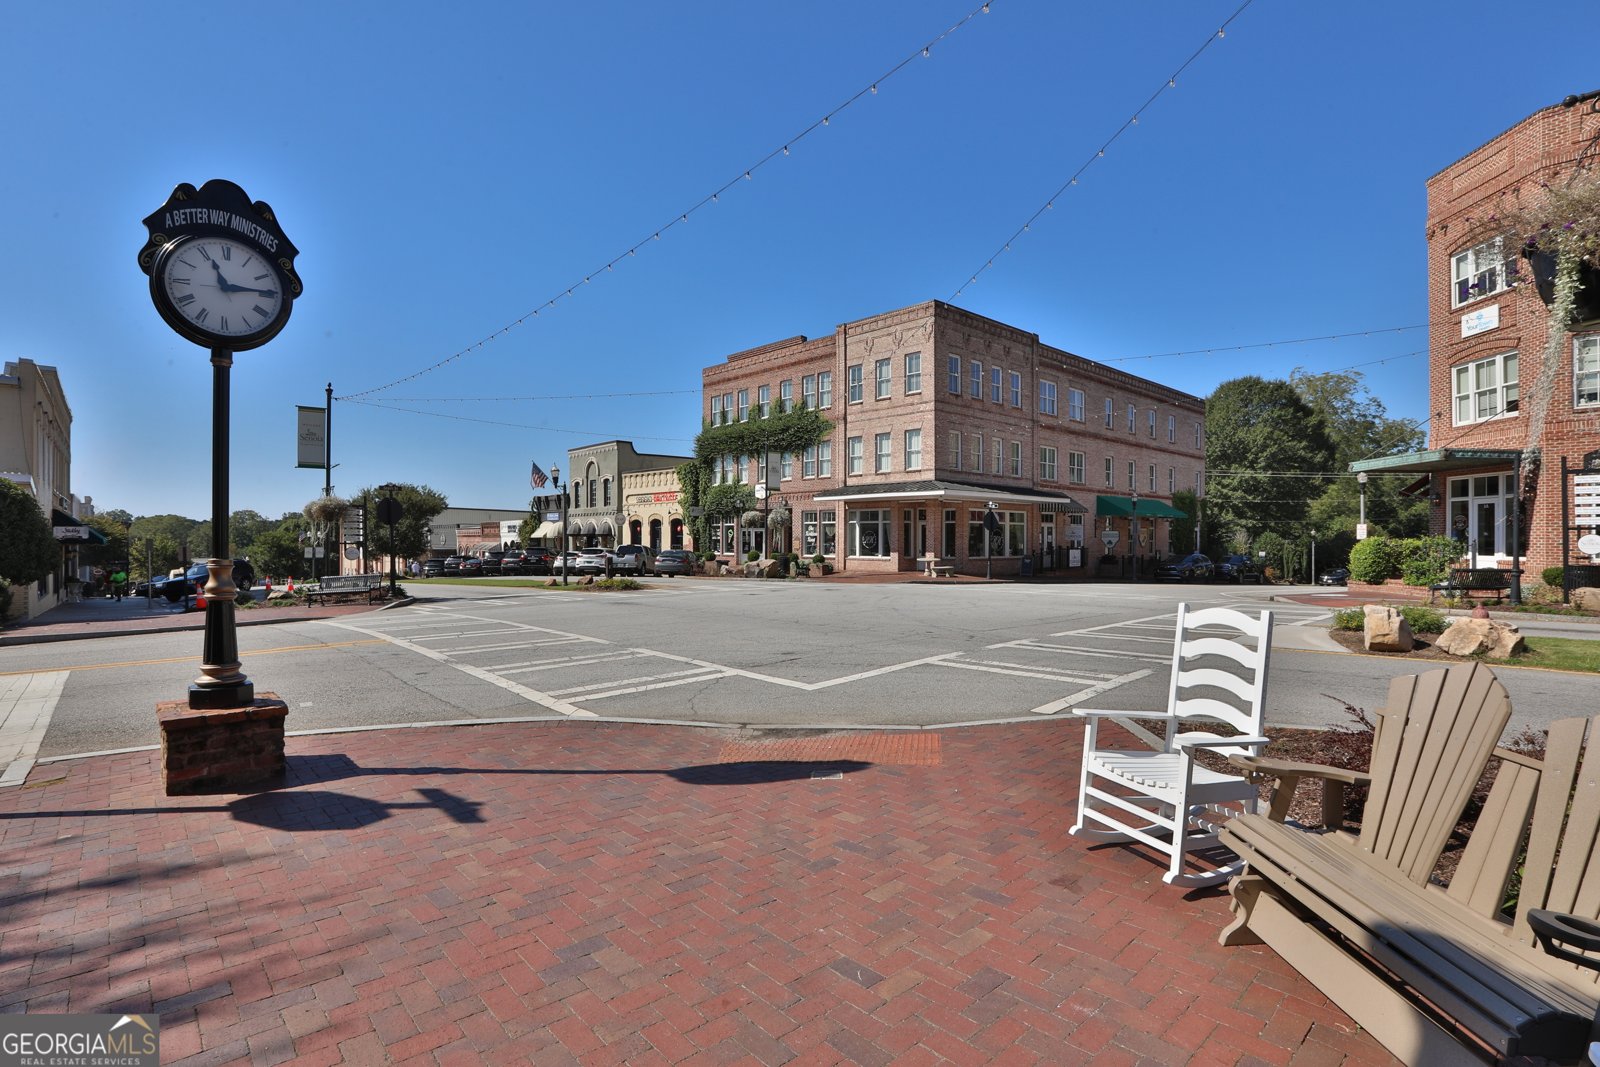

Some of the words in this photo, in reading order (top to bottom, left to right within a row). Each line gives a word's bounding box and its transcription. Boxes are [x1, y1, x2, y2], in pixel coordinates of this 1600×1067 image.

[165, 213, 173, 228] A
[174, 208, 208, 225] BETTER
[210, 209, 229, 227] WAY
[231, 215, 279, 253] MINISTRIES
